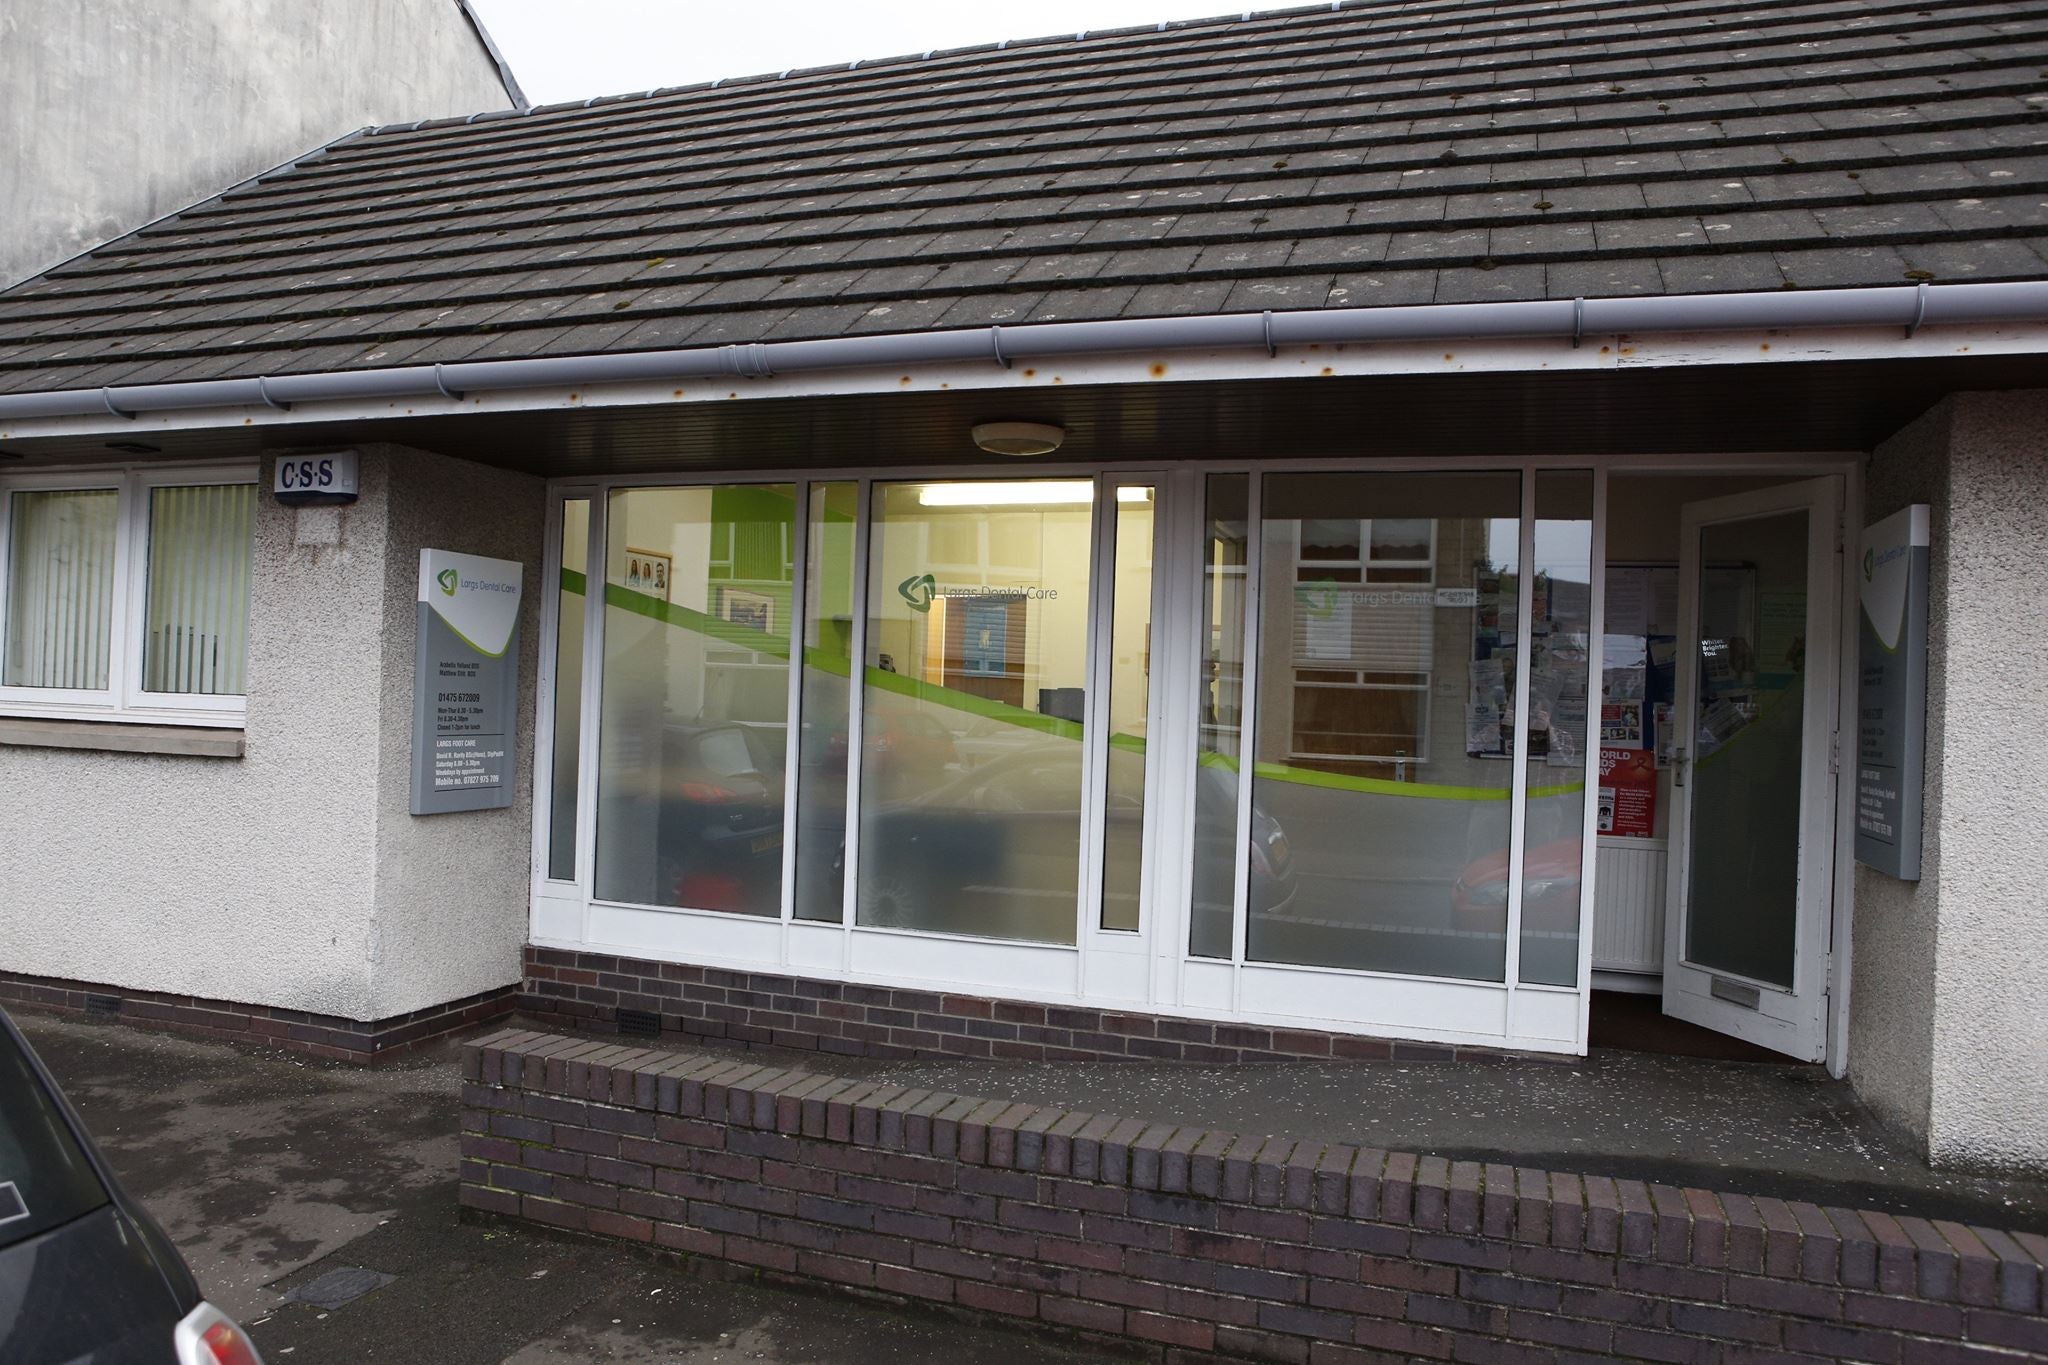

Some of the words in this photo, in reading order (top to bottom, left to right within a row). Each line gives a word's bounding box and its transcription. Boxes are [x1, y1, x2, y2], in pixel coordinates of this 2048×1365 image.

[461, 579, 479, 591] Largs
[480, 580, 500, 591] Dental
[501, 583, 516, 593] Care
[943, 586, 977, 600] Largs
[982, 585, 1023, 599] Dental
[1026, 586, 1057, 600] Care
[438, 692, 457, 702] 01475
[464, 739, 476, 747] CARE
[1600, 750, 1631, 761] ORLD
[1600, 759, 1616, 768] DS
[1600, 767, 1611, 776] AY
[435, 777, 453, 786] Mobile
[480, 775, 489, 783] 975
